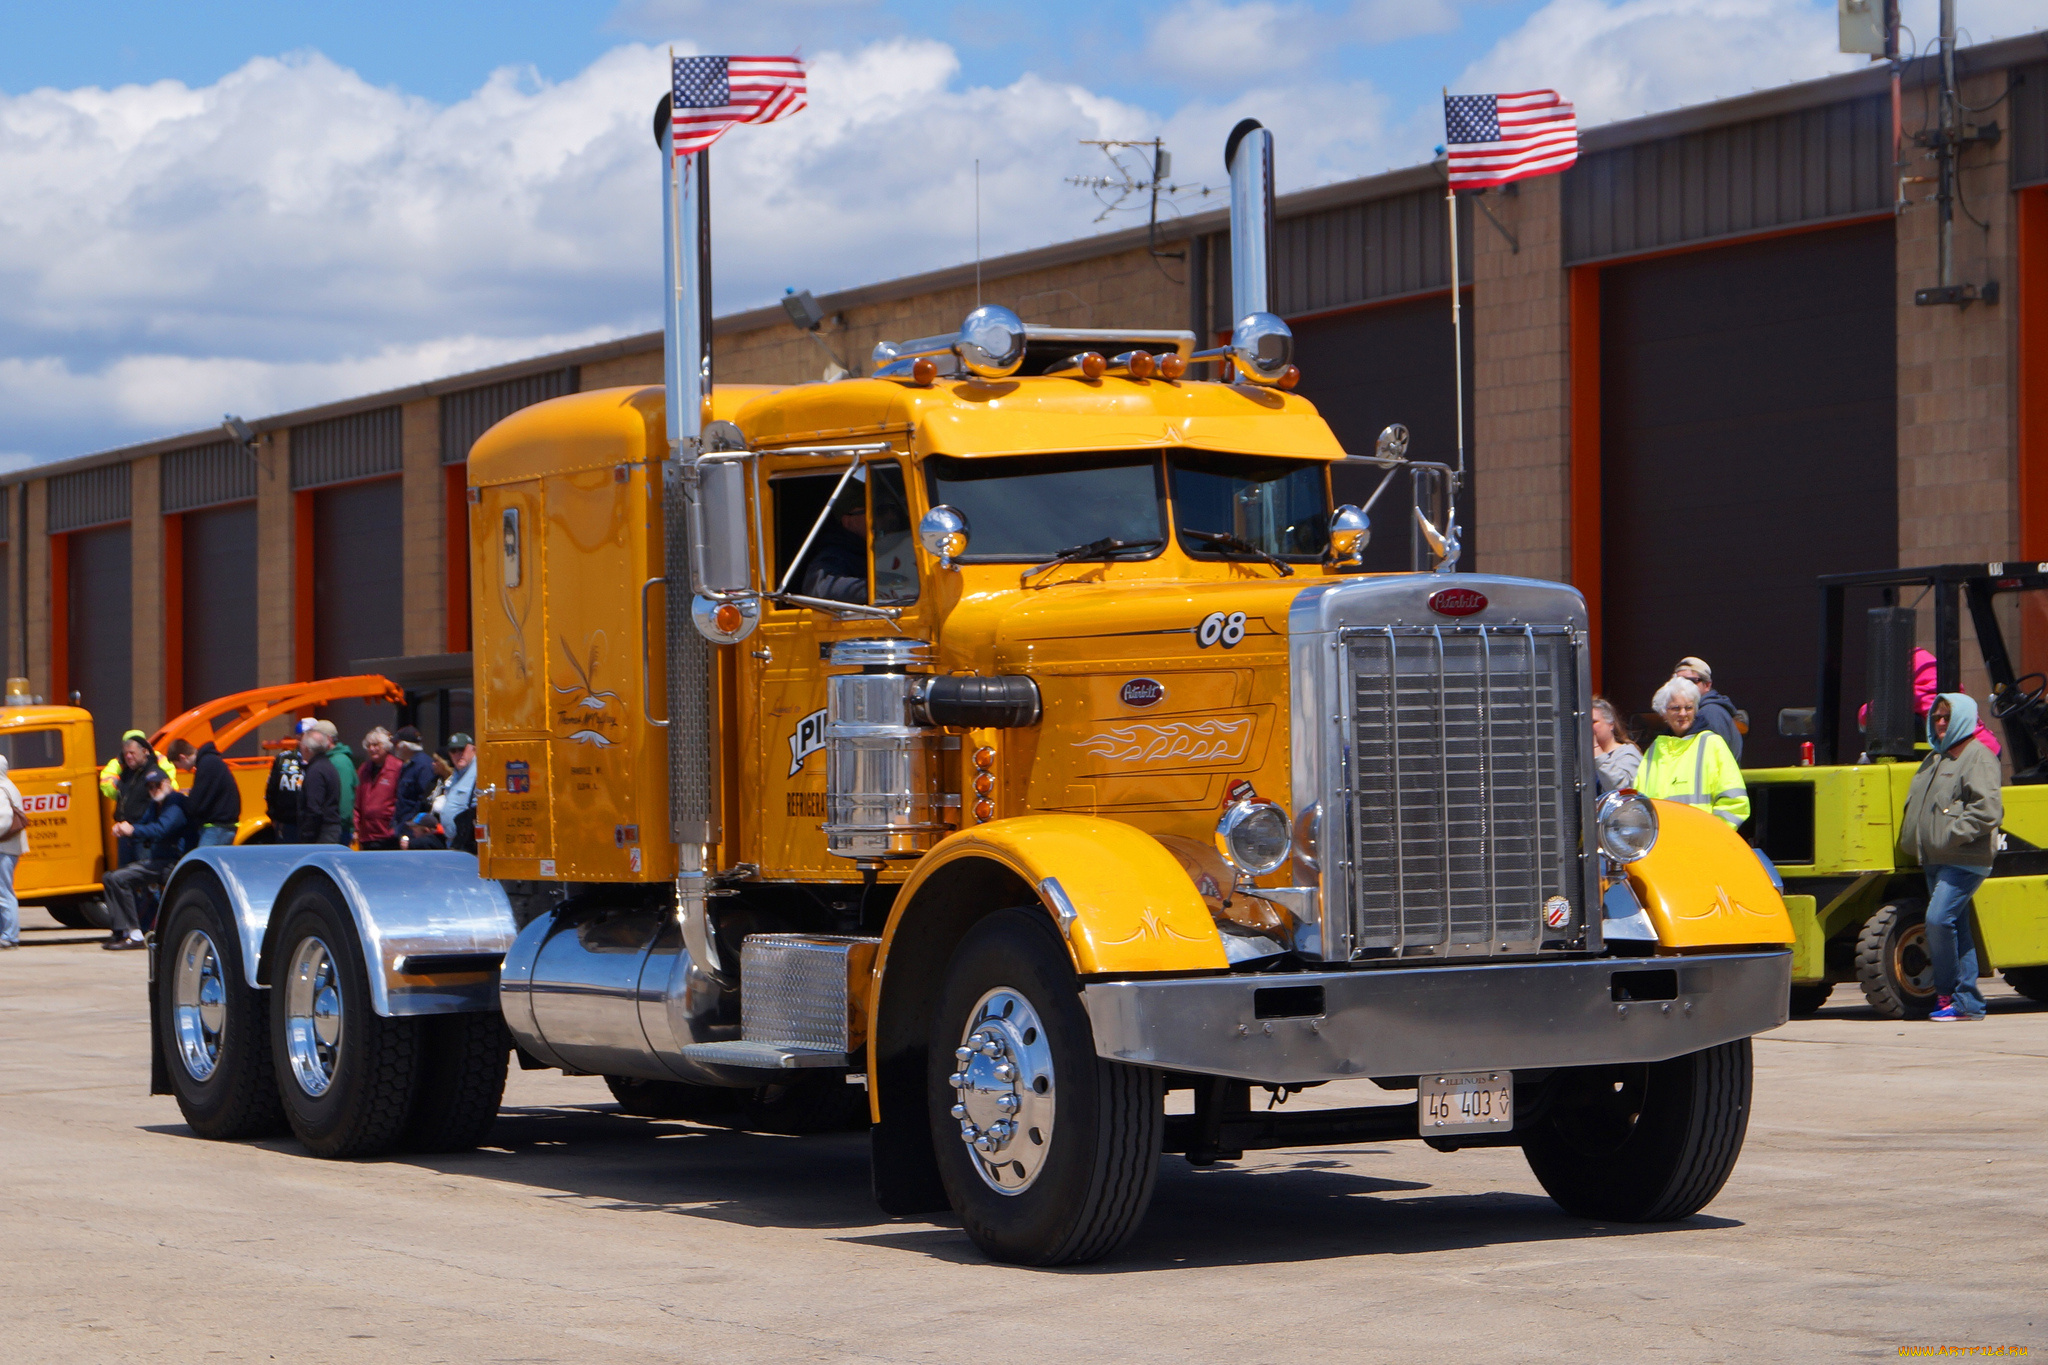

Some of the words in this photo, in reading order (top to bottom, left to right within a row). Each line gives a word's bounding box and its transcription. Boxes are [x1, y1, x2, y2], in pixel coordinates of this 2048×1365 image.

[1435, 593, 1484, 609] Peterbilt
[1196, 610, 1247, 649] 68
[1124, 684, 1159, 701] Peterbilt
[1446, 1077, 1487, 1086] ILLINOIS
[1429, 1092, 1449, 1119] 46
[1462, 1089, 1492, 1117] 403
